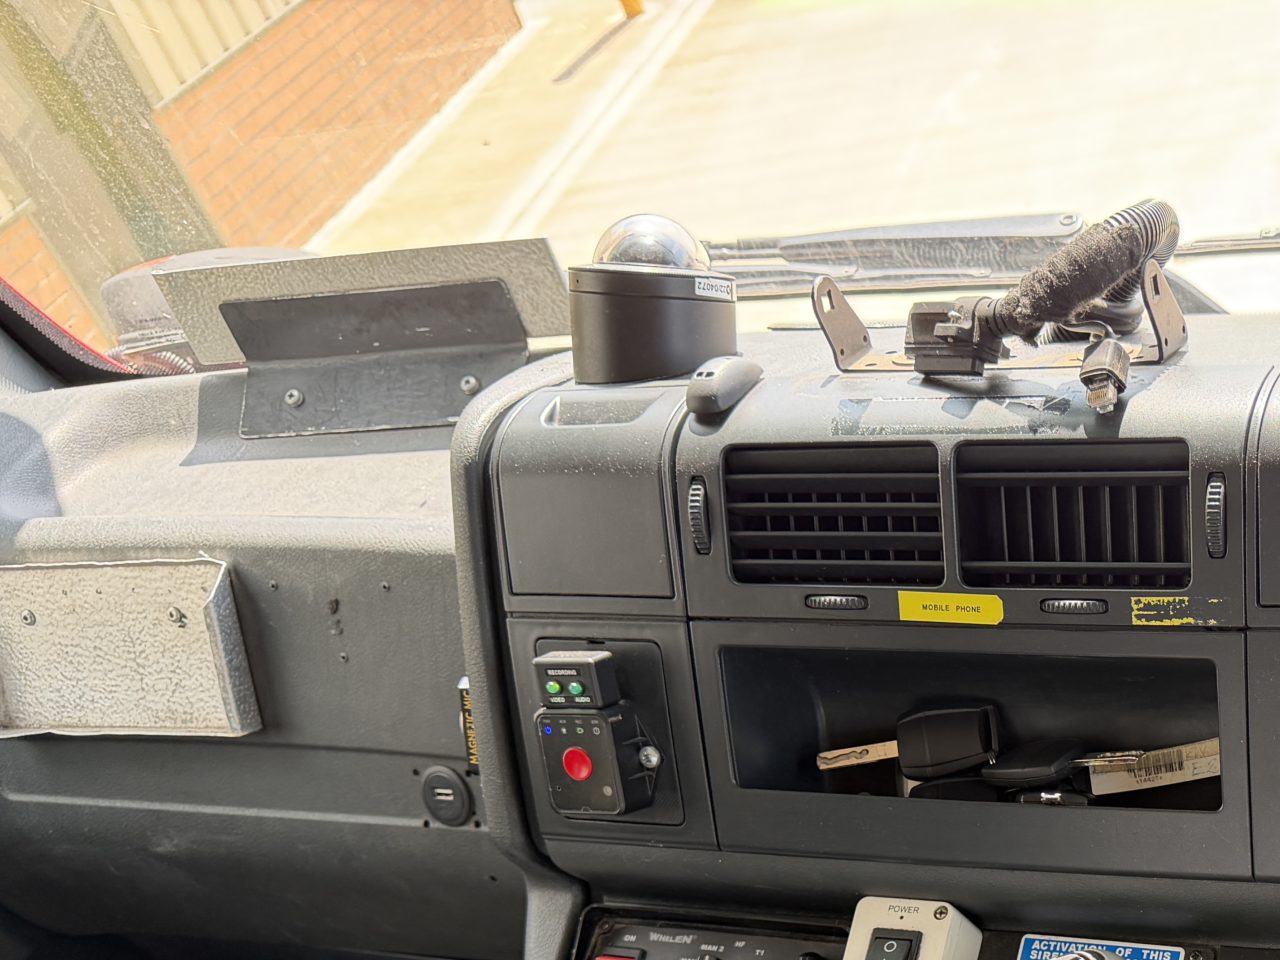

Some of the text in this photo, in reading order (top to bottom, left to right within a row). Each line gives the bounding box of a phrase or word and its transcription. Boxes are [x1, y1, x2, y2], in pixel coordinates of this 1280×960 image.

[922, 604, 981, 613] MOBILE PHONE
[888, 905, 920, 914] POWER
[624, 934, 637, 942] ON
[649, 932, 694, 945] WHELEN
[700, 943, 718, 951] MAN
[1030, 949, 1064, 960] SIRE
[1115, 947, 1132, 957] OF
[1142, 949, 1171, 960] THIS
